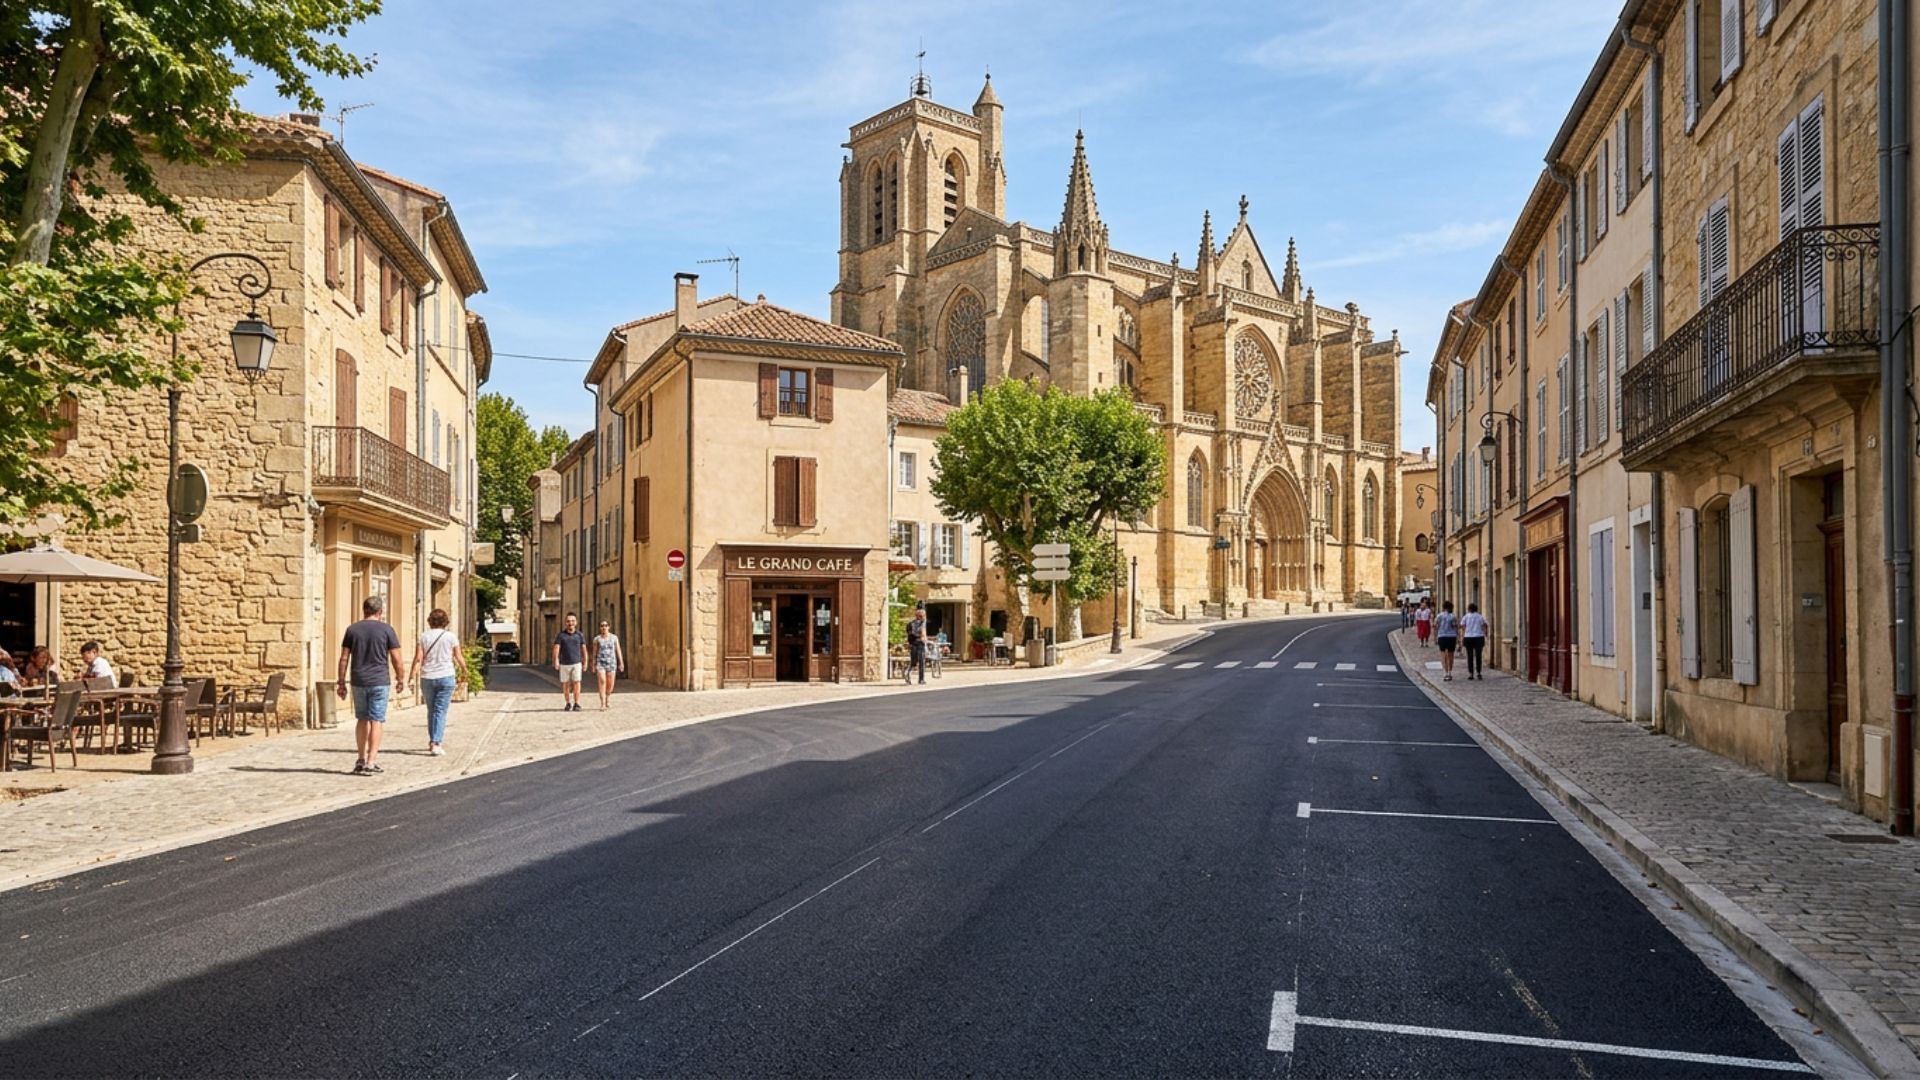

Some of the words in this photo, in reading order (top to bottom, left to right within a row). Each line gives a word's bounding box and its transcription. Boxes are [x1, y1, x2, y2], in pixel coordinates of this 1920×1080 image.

[738, 557, 756, 569] LE
[760, 557, 812, 570] GRAND
[816, 558, 853, 571] CAFE
